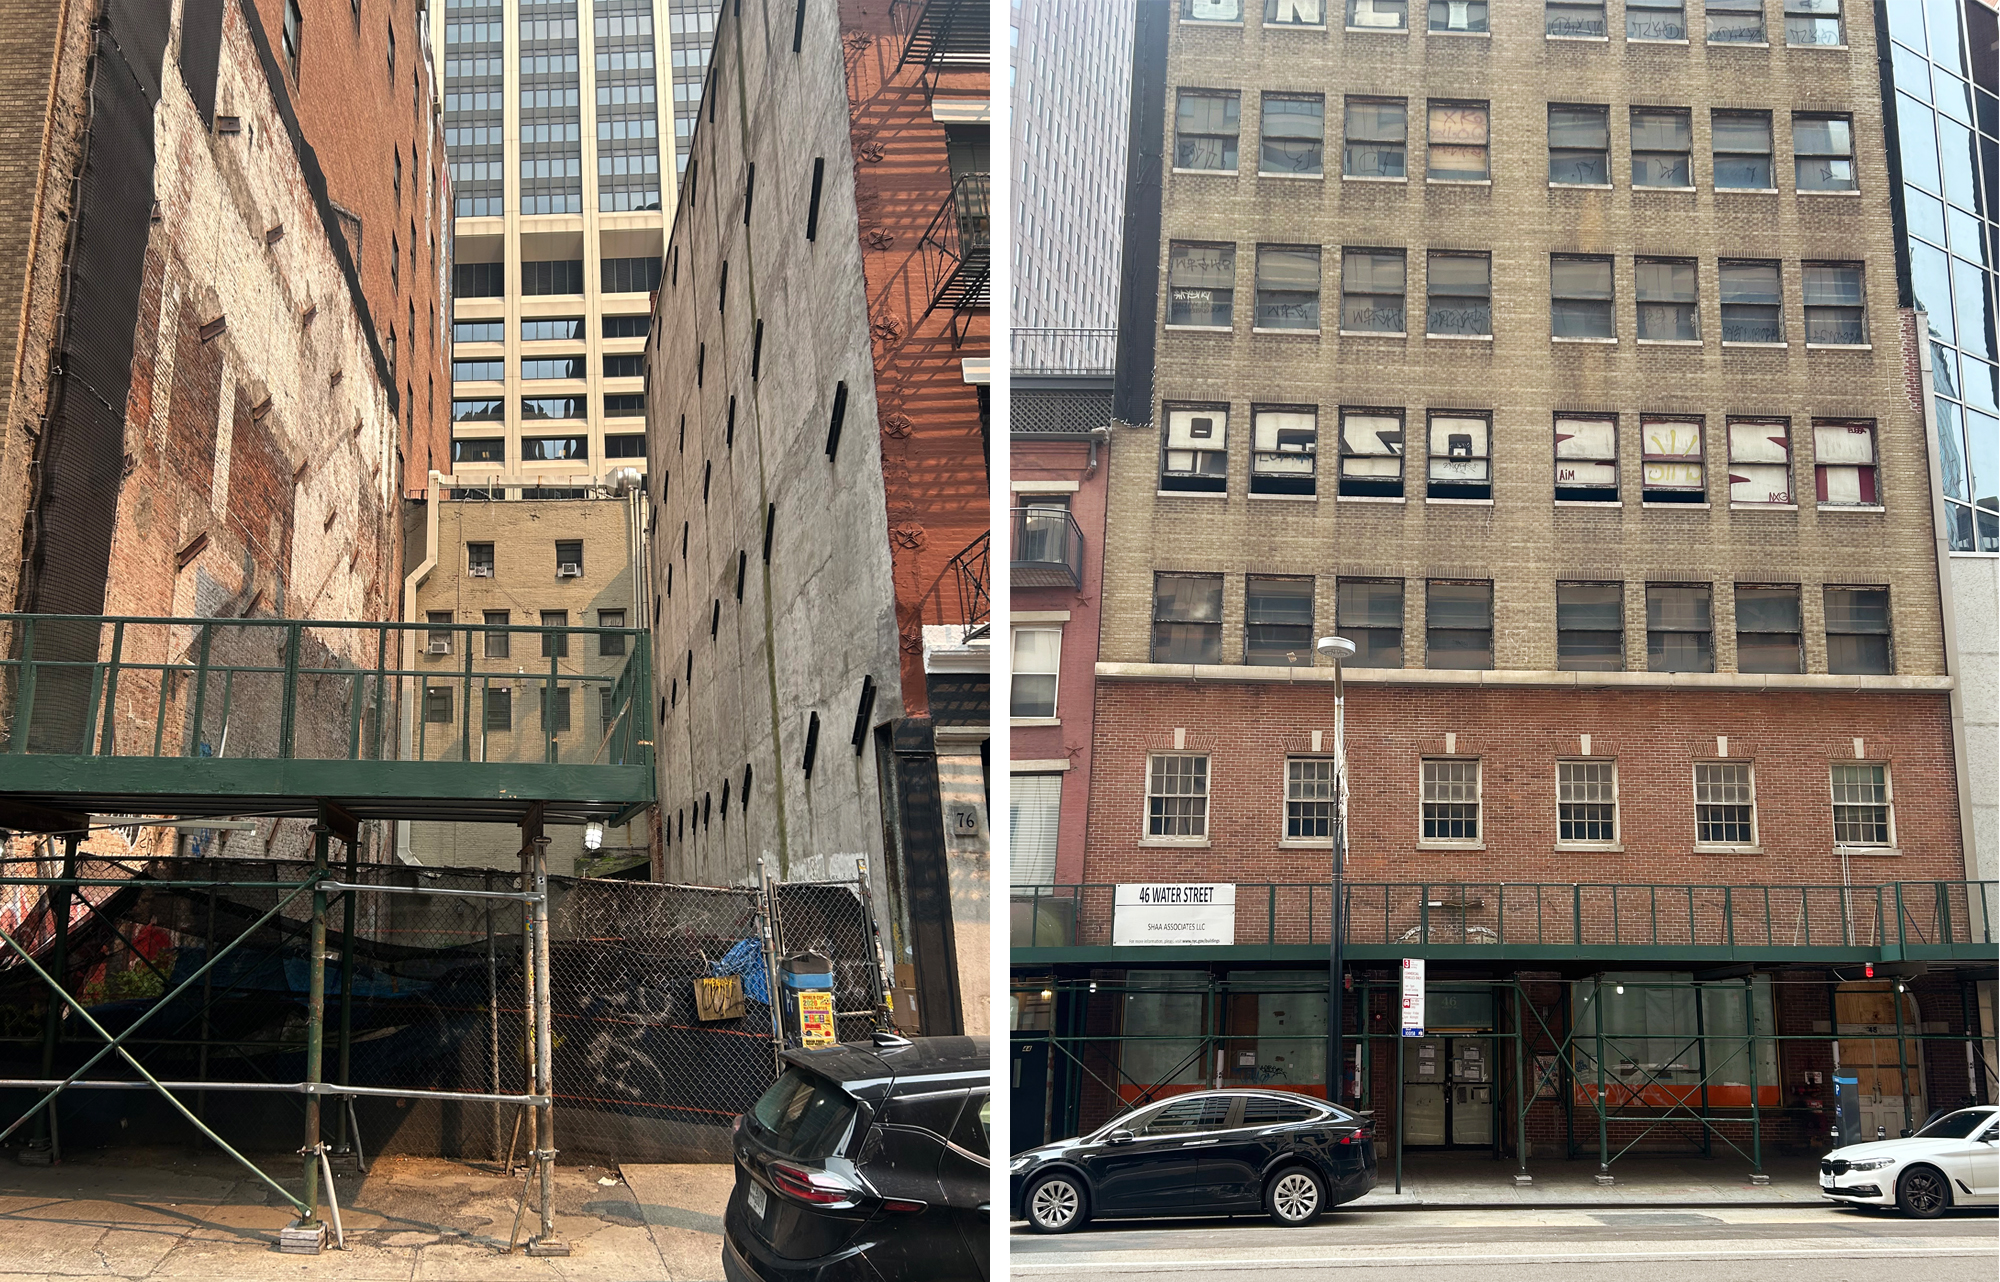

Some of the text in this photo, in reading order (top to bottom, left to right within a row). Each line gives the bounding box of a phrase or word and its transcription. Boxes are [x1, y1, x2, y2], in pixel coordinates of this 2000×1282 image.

[956, 812, 975, 828] 76
[1139, 886, 1214, 903] 46 WATER STREET
[1148, 923, 1206, 931] SHAA ASSOCIATES LLC
[1404, 960, 1409, 968] 3
[1441, 996, 1457, 1006] 46
[1835, 1084, 1840, 1094] P
